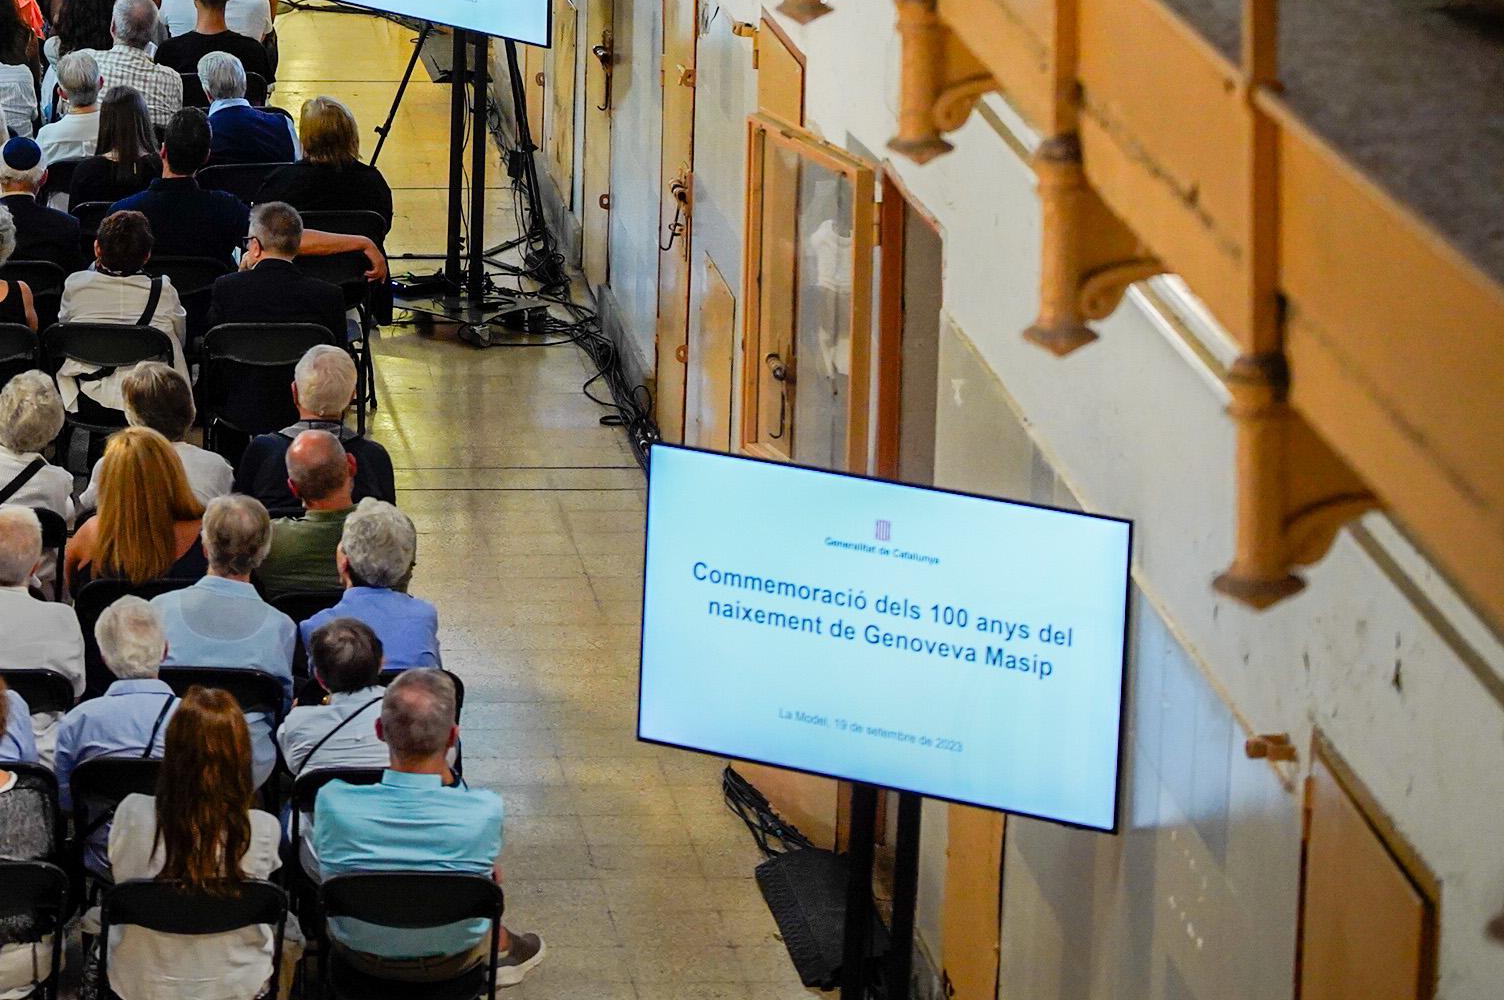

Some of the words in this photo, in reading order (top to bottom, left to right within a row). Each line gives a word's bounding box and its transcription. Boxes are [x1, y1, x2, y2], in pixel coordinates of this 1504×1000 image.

[824, 536, 876, 553] Generalitat
[879, 547, 889, 556] de
[893, 548, 940, 565] Catalunya
[693, 561, 867, 610] Commemoració
[875, 595, 921, 620] dels
[931, 604, 968, 628] 100
[976, 616, 1030, 642] anys
[1039, 624, 1073, 648] del
[708, 600, 822, 635] naixement
[829, 618, 856, 640] de
[864, 624, 976, 663] Genoveva
[985, 646, 1053, 680] Masip
[778, 708, 793, 720] La
[834, 718, 847, 730] 19
[850, 723, 863, 734] de
[865, 726, 916, 744] setembre
[918, 735, 933, 747] de
[935, 737, 964, 753] 2023
